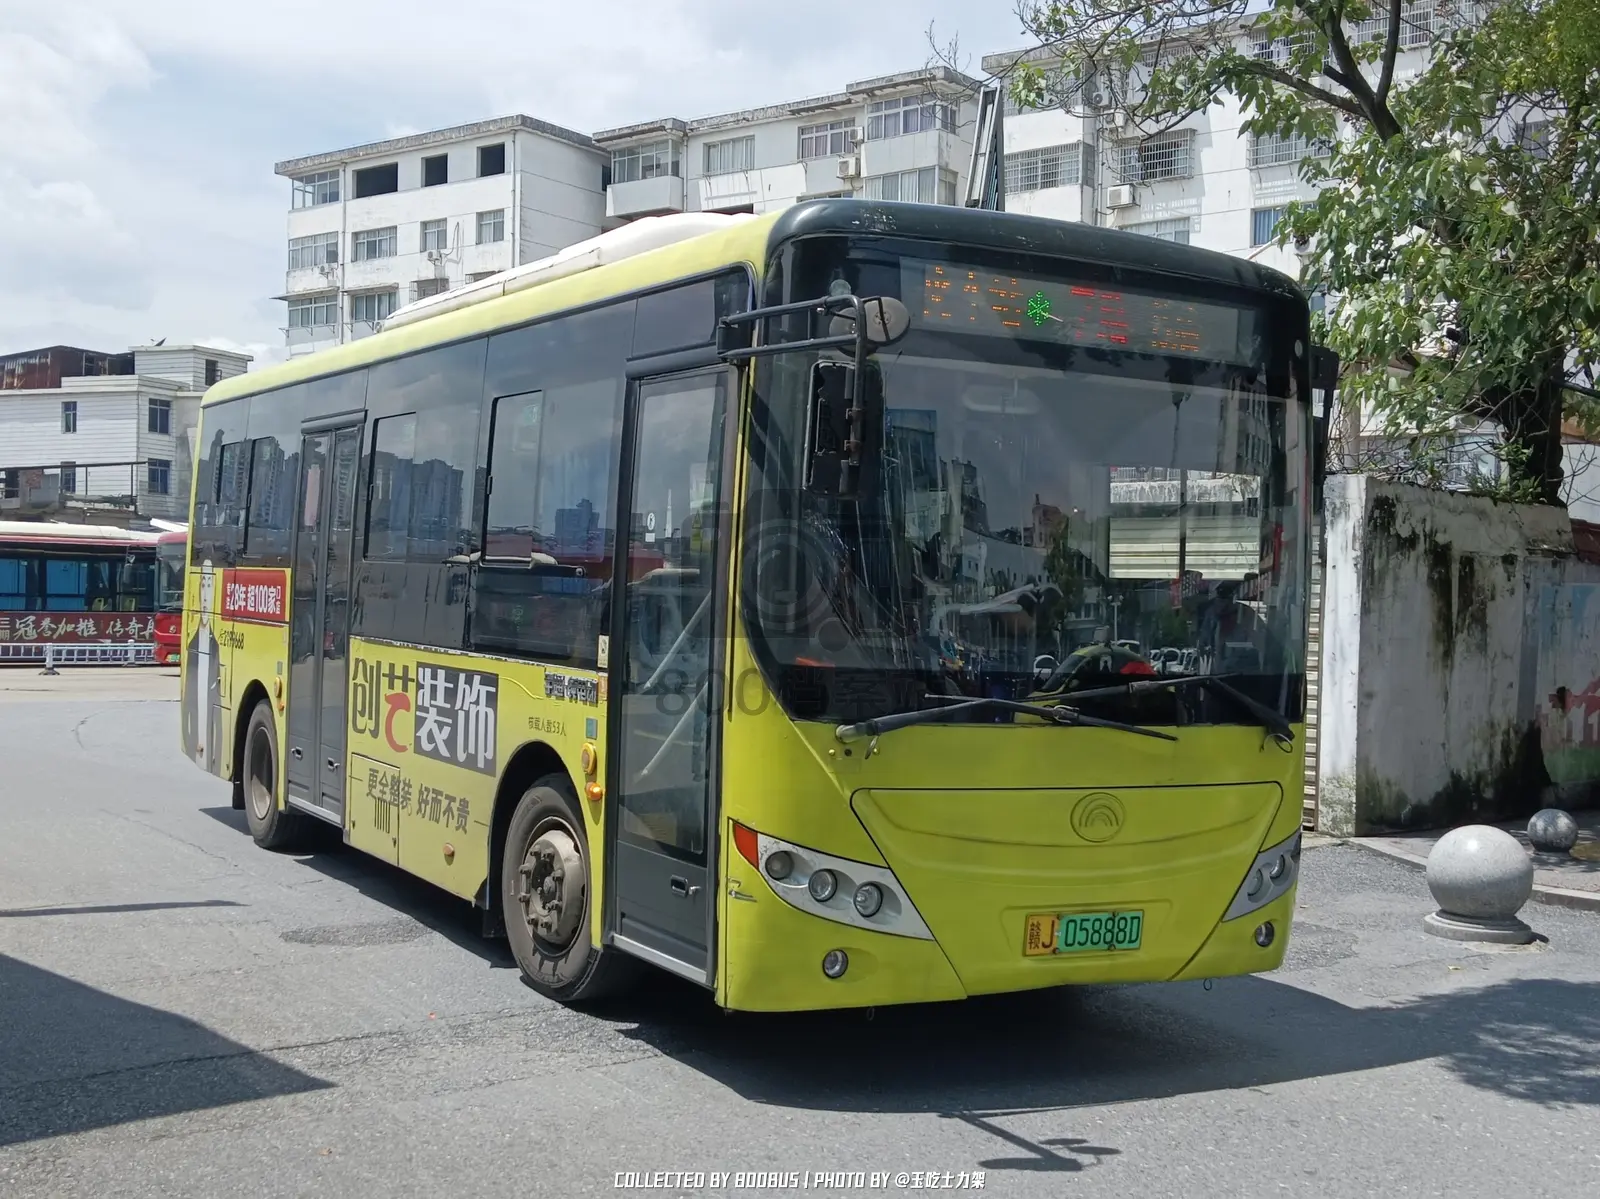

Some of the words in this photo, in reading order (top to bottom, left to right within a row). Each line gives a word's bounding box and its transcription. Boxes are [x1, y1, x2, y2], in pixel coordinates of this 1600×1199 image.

[366, 768, 412, 810] 更全整装
[416, 783, 470, 835] 好而不贵
